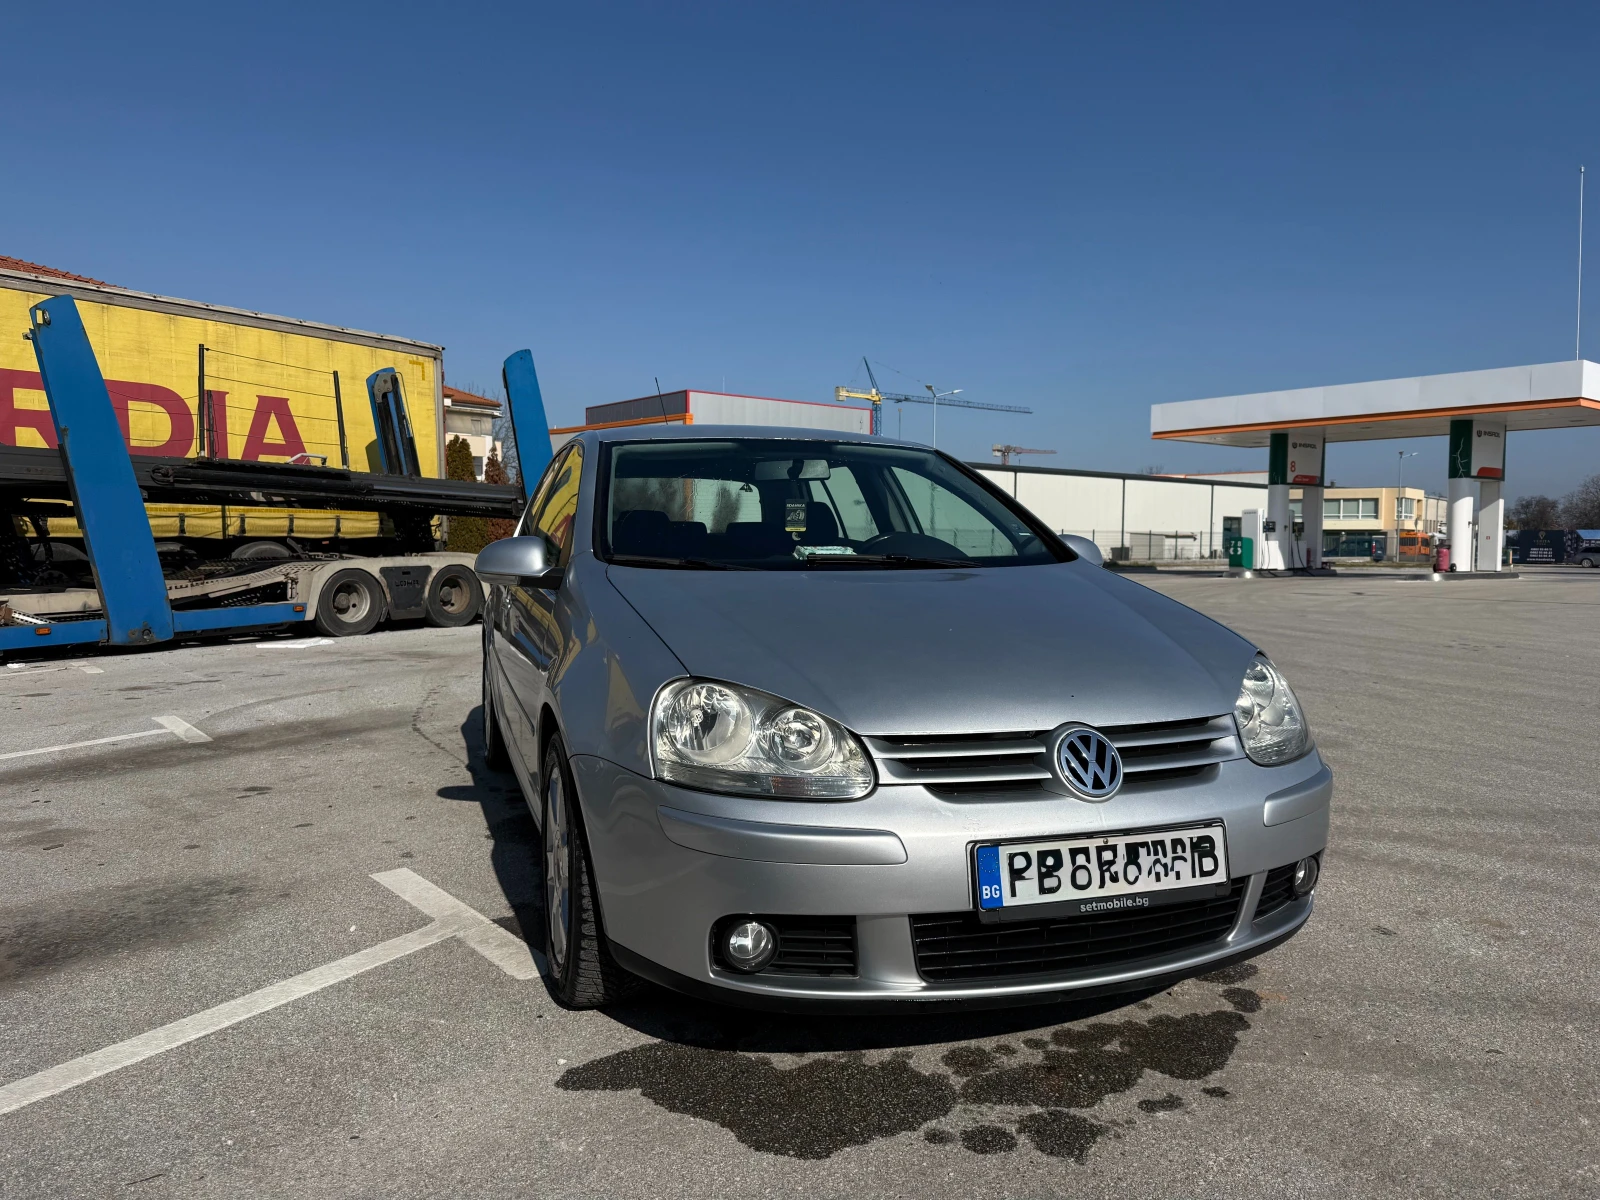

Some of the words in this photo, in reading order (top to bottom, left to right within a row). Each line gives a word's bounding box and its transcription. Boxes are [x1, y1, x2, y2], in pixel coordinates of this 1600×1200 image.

[1290, 460, 1296, 473] 8
[981, 884, 1001, 899] BG
[1079, 896, 1149, 912] setmobile.bg
